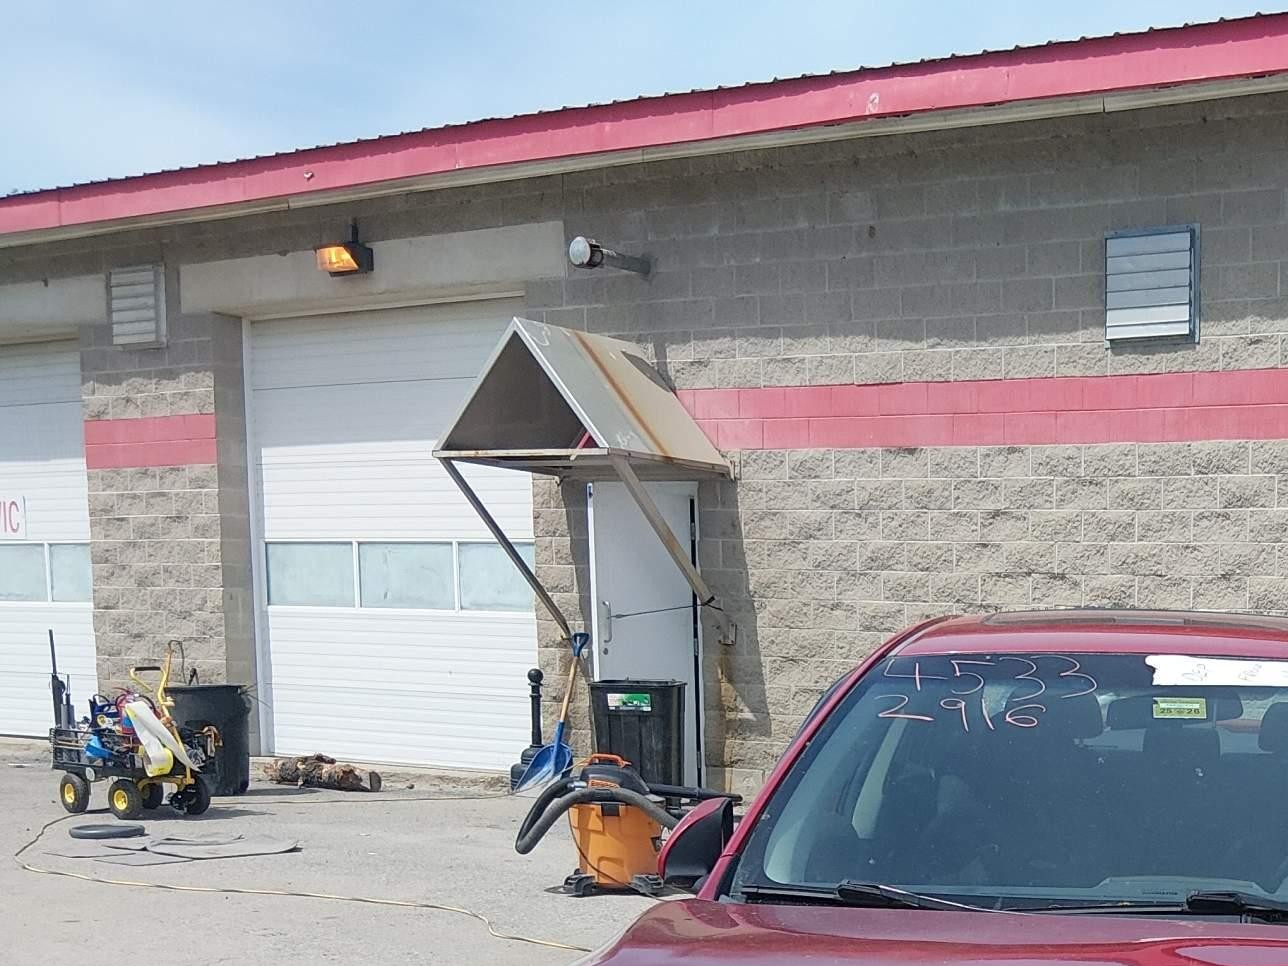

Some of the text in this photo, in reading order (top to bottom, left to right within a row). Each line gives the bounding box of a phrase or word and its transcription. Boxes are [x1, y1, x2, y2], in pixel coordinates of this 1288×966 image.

[0, 500, 20, 533] IC
[883, 655, 1098, 701] 4533
[874, 694, 1047, 732] 2916
